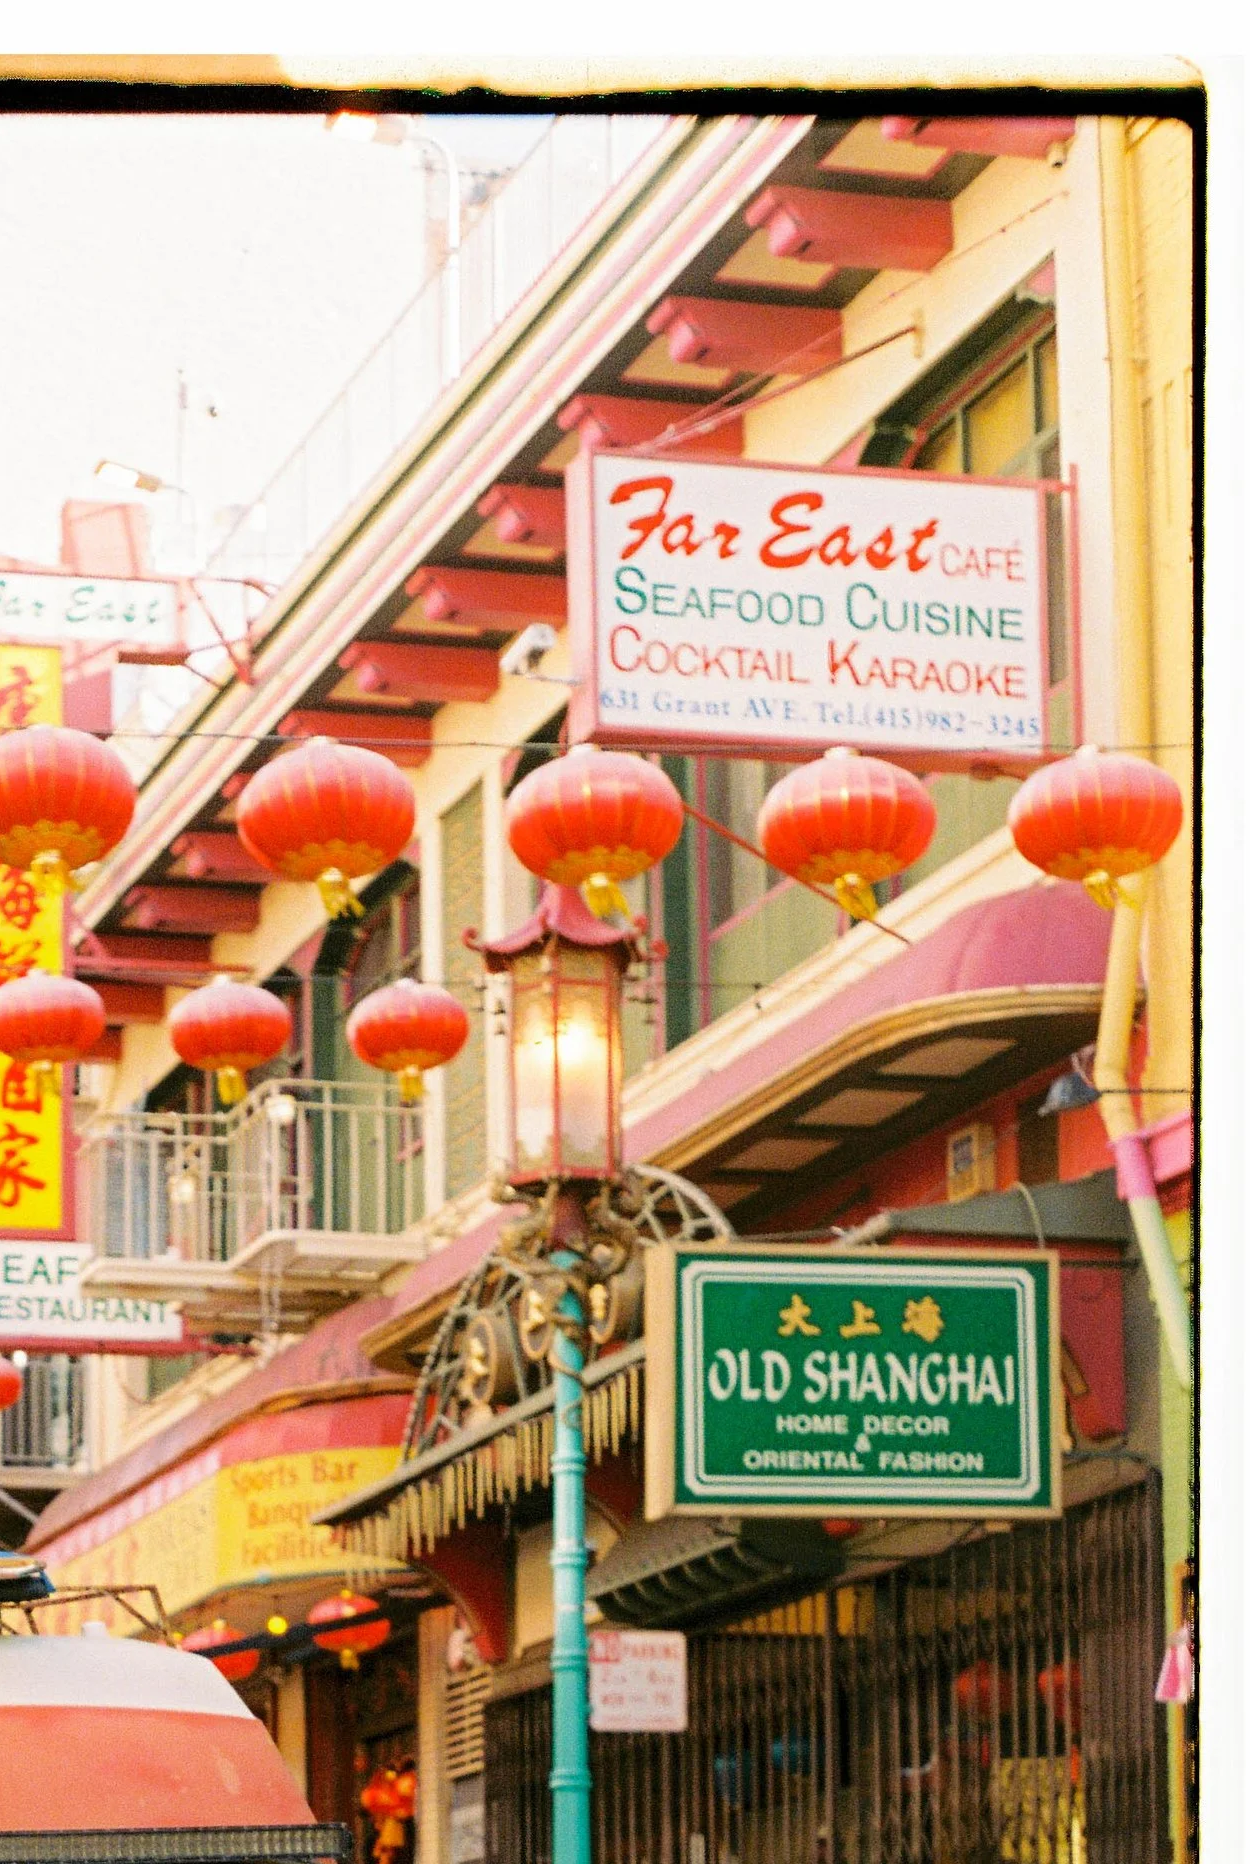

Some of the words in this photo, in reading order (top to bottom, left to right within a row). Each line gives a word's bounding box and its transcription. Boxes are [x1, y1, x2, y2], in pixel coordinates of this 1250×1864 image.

[608, 475, 742, 562] Far
[757, 492, 940, 573] East
[939, 541, 1027, 583] CAFÉ
[65, 585, 162, 625] East
[613, 565, 825, 628] SEAFOOD
[848, 582, 1026, 643] CUISINE
[608, 624, 812, 685] COCKTAIL
[828, 639, 1029, 700] KARAOKE
[598, 692, 640, 712] 631
[652, 693, 731, 717] Grant
[708, 1348, 792, 1402] OLD
[803, 1350, 1015, 1406] SHANGHAI
[776, 1414, 848, 1435] HOME
[863, 1415, 951, 1436] DECOR
[743, 1450, 864, 1472] ORIENTAL
[878, 1453, 985, 1473] FASHION
